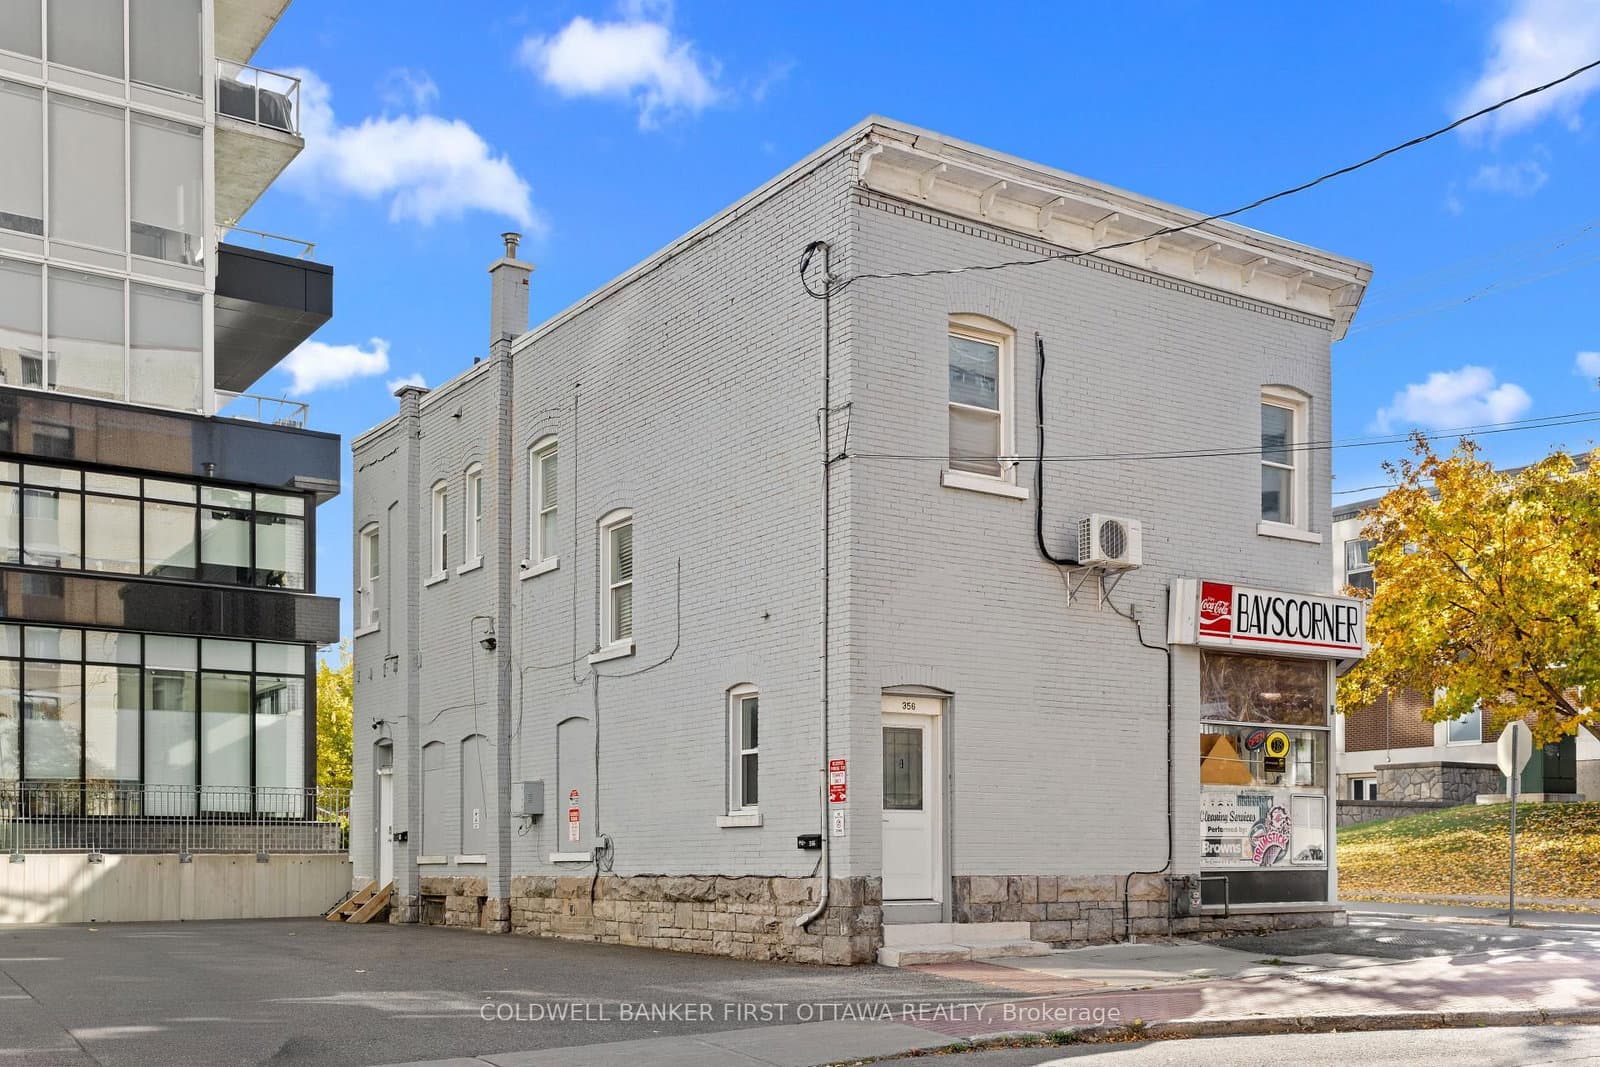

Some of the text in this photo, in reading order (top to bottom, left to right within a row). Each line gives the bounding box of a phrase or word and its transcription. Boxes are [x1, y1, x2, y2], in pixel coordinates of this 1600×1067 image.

[1237, 593, 1358, 644] BAYSCORNER
[902, 701, 916, 711] 356
[1229, 810, 1256, 823] Services
[1201, 840, 1242, 855] Browns
[1253, 831, 1288, 864] DRUMSTICK
